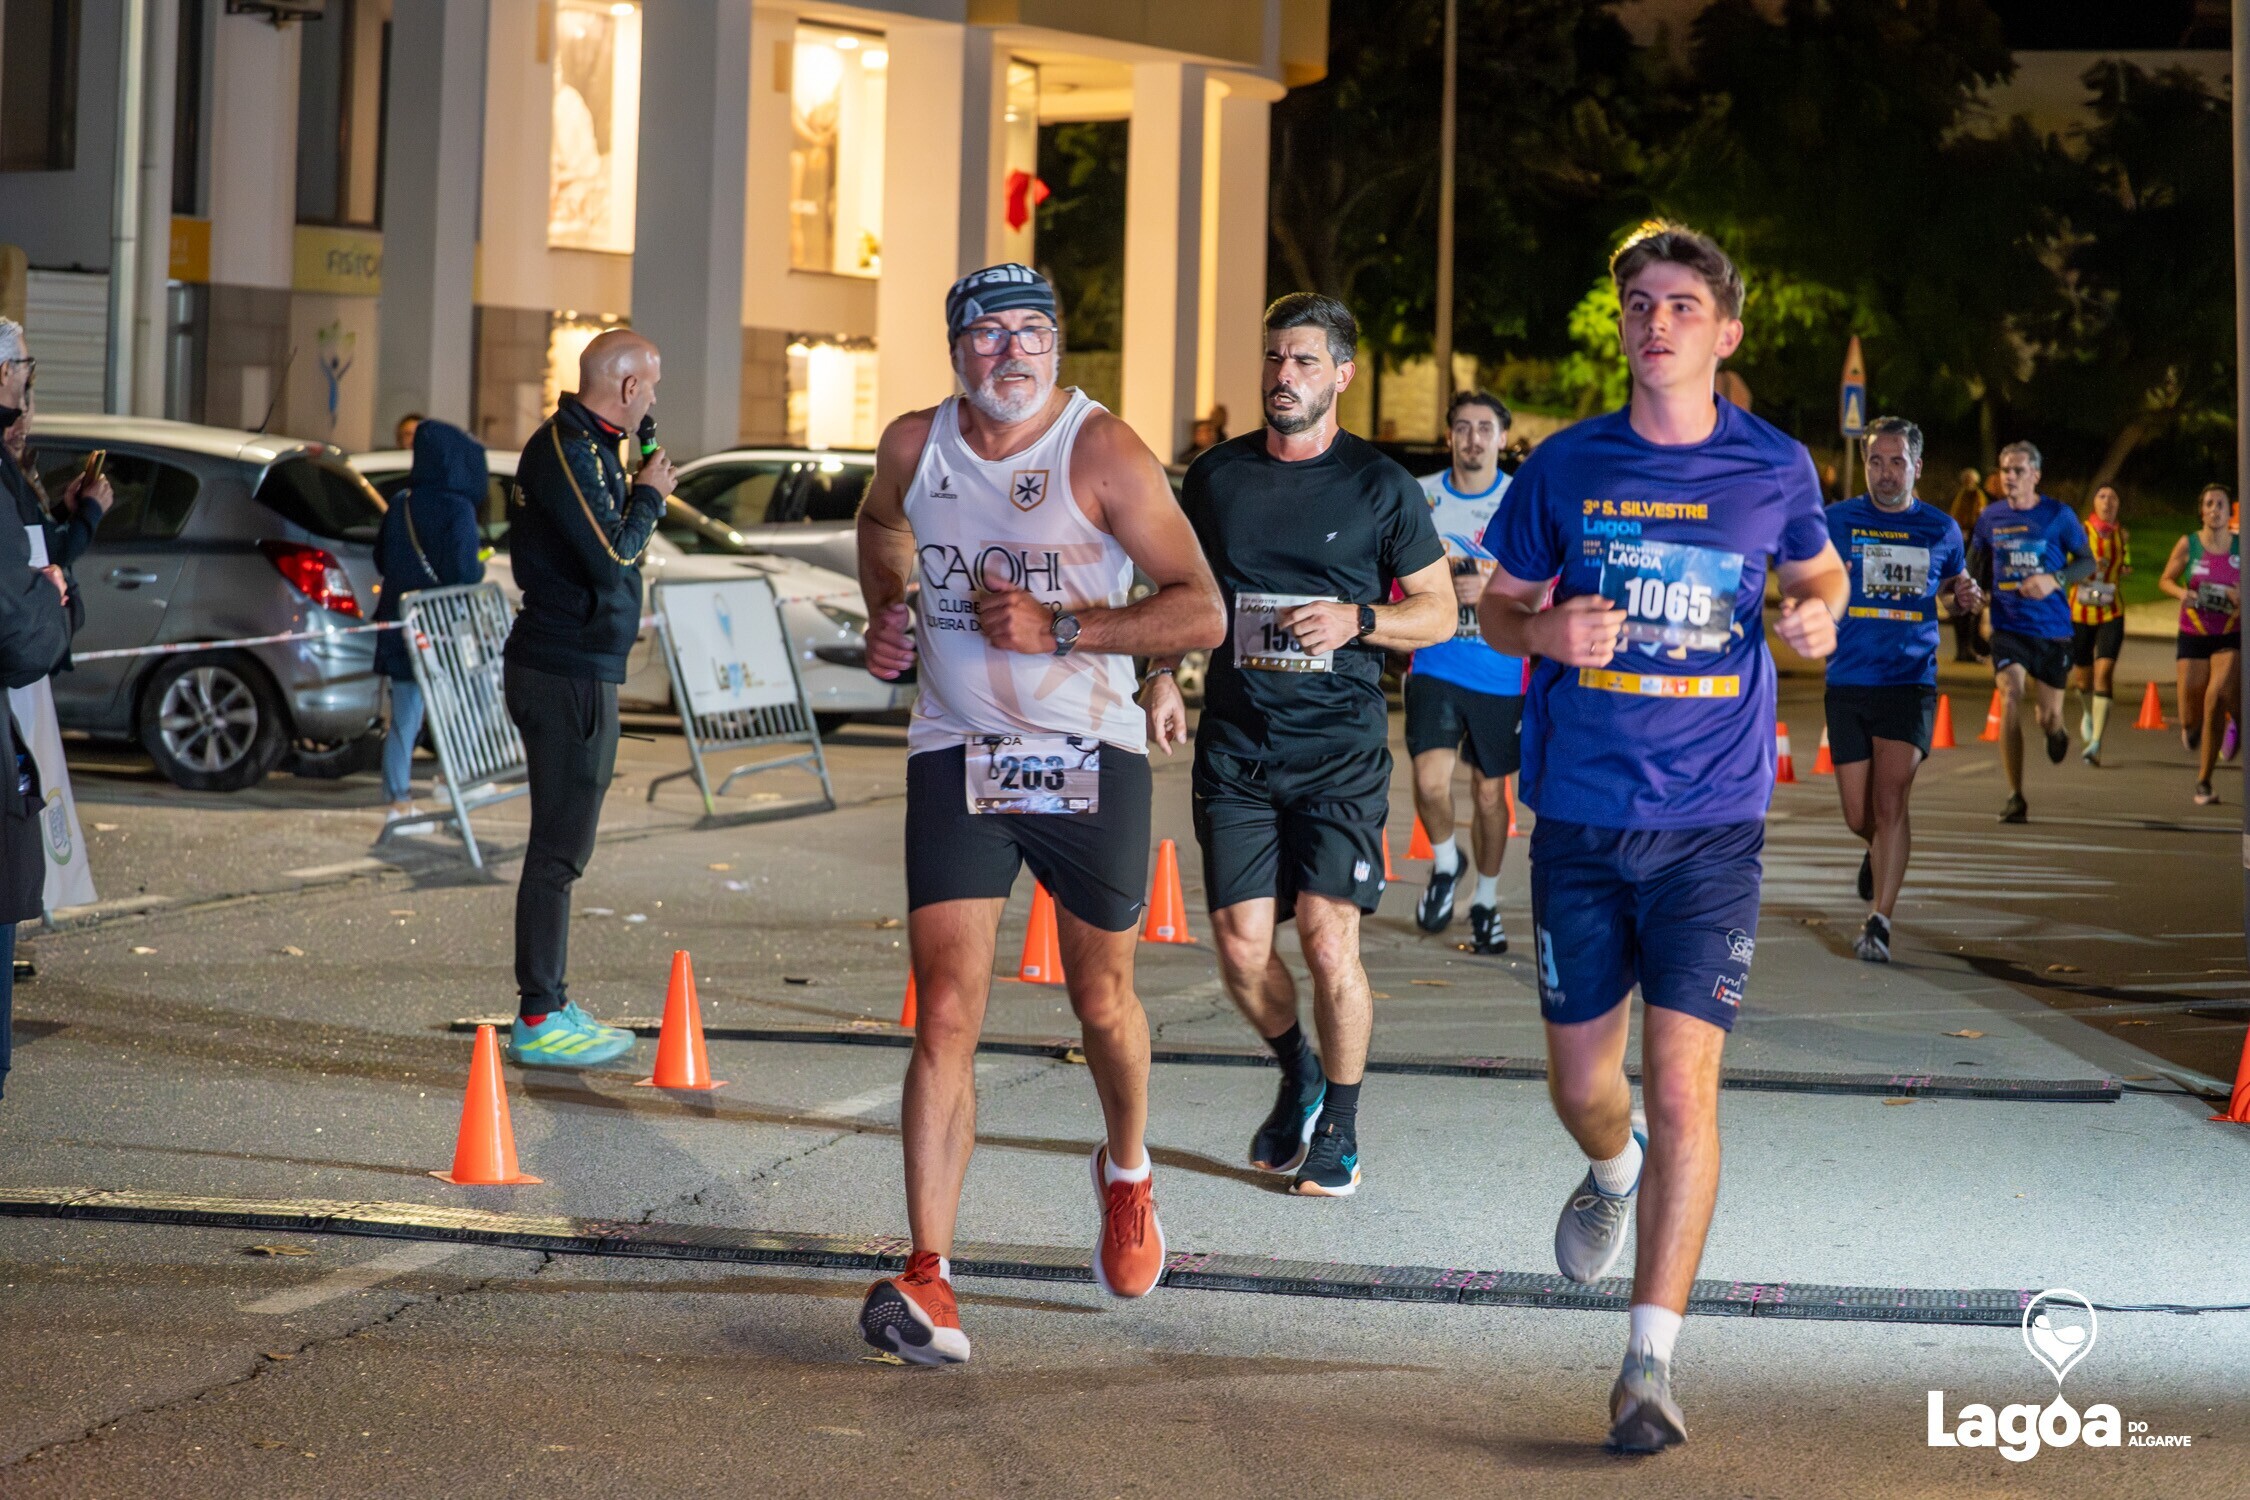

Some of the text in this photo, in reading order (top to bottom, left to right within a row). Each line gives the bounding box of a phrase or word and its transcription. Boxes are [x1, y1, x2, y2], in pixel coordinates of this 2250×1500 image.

[1602, 501, 1618, 516] S.
[1620, 502, 1708, 520] SILVESTRE
[1583, 516, 1642, 538] Lagoa
[1608, 550, 1662, 570] LAGOA
[1882, 563, 1912, 582] 441
[1241, 604, 1275, 614] LAGOA
[1625, 577, 1712, 626] 1065
[1000, 755, 1065, 791] 203
